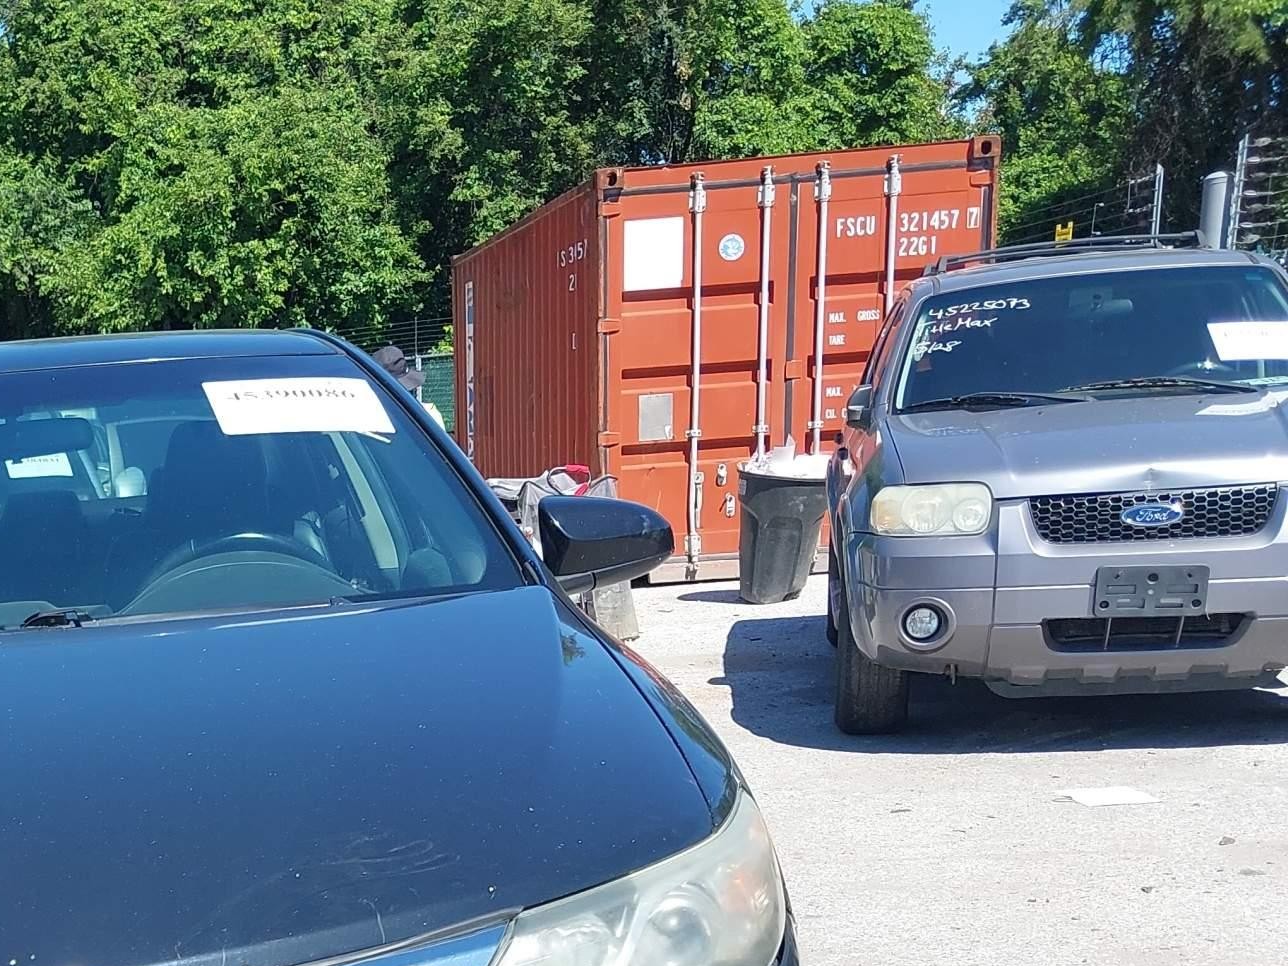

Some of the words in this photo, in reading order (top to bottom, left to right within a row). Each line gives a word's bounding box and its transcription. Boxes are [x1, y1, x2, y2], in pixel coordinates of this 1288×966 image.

[836, 215, 876, 238] FSCU
[900, 209, 960, 232] 321457
[968, 208, 979, 228] 7
[898, 236, 937, 257] 22G1
[857, 309, 880, 321] GROSS
[929, 298, 1031, 319] 45225073
[829, 335, 845, 345] TARE
[1136, 508, 1170, 521] Ford
